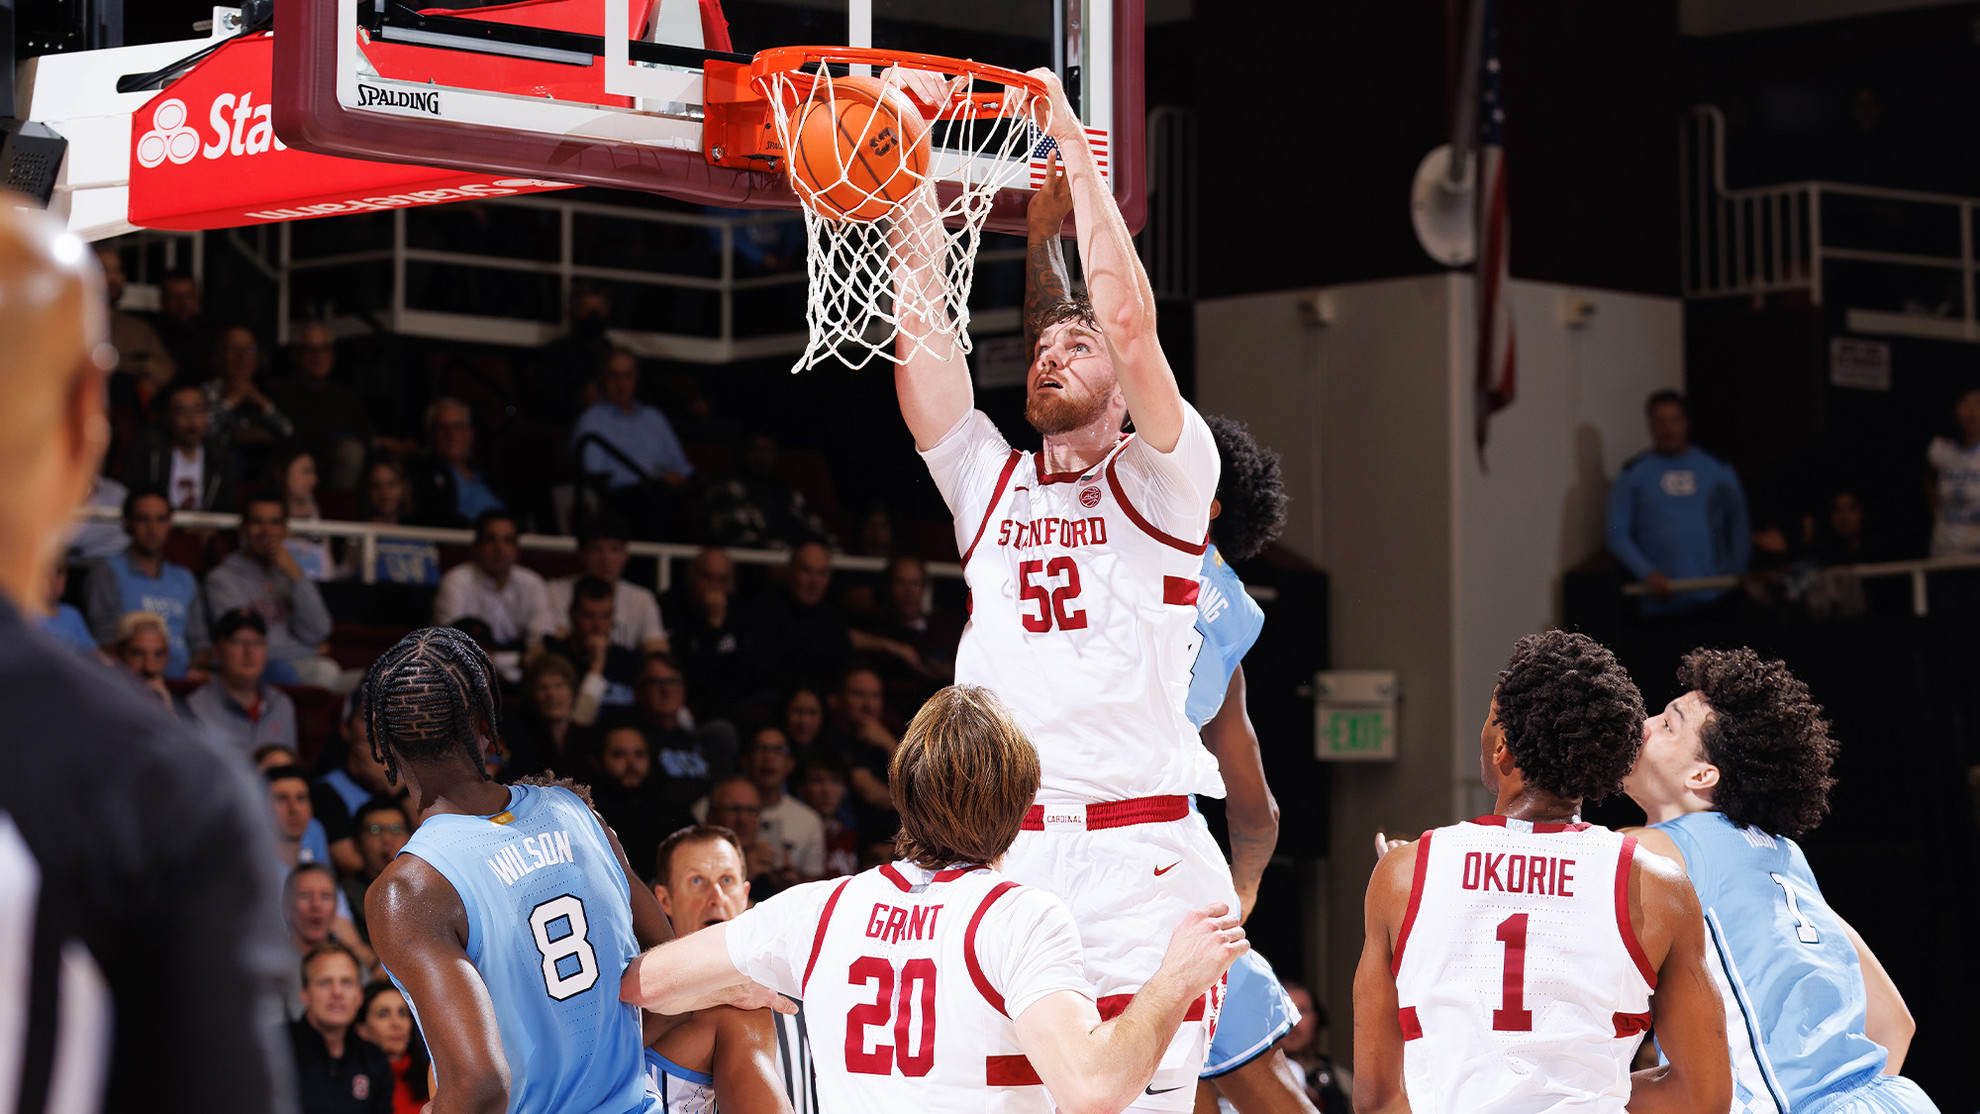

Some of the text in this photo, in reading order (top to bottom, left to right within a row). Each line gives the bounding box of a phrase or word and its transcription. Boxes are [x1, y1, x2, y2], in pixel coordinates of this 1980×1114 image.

[203, 92, 288, 160] Sta
[358, 83, 439, 115] SPALDING
[998, 516, 1108, 551] STNFORD
[1019, 556, 1088, 633] 52
[1330, 712, 1383, 752] EXIT
[1046, 815, 1082, 824] CARDINAL
[488, 830, 574, 886] WILSON
[1461, 851, 1576, 897] OKORIE
[1769, 871, 1820, 944] 1
[528, 893, 600, 1003] 8
[1492, 913, 1532, 1032] 1
[845, 955, 937, 1078] 20
